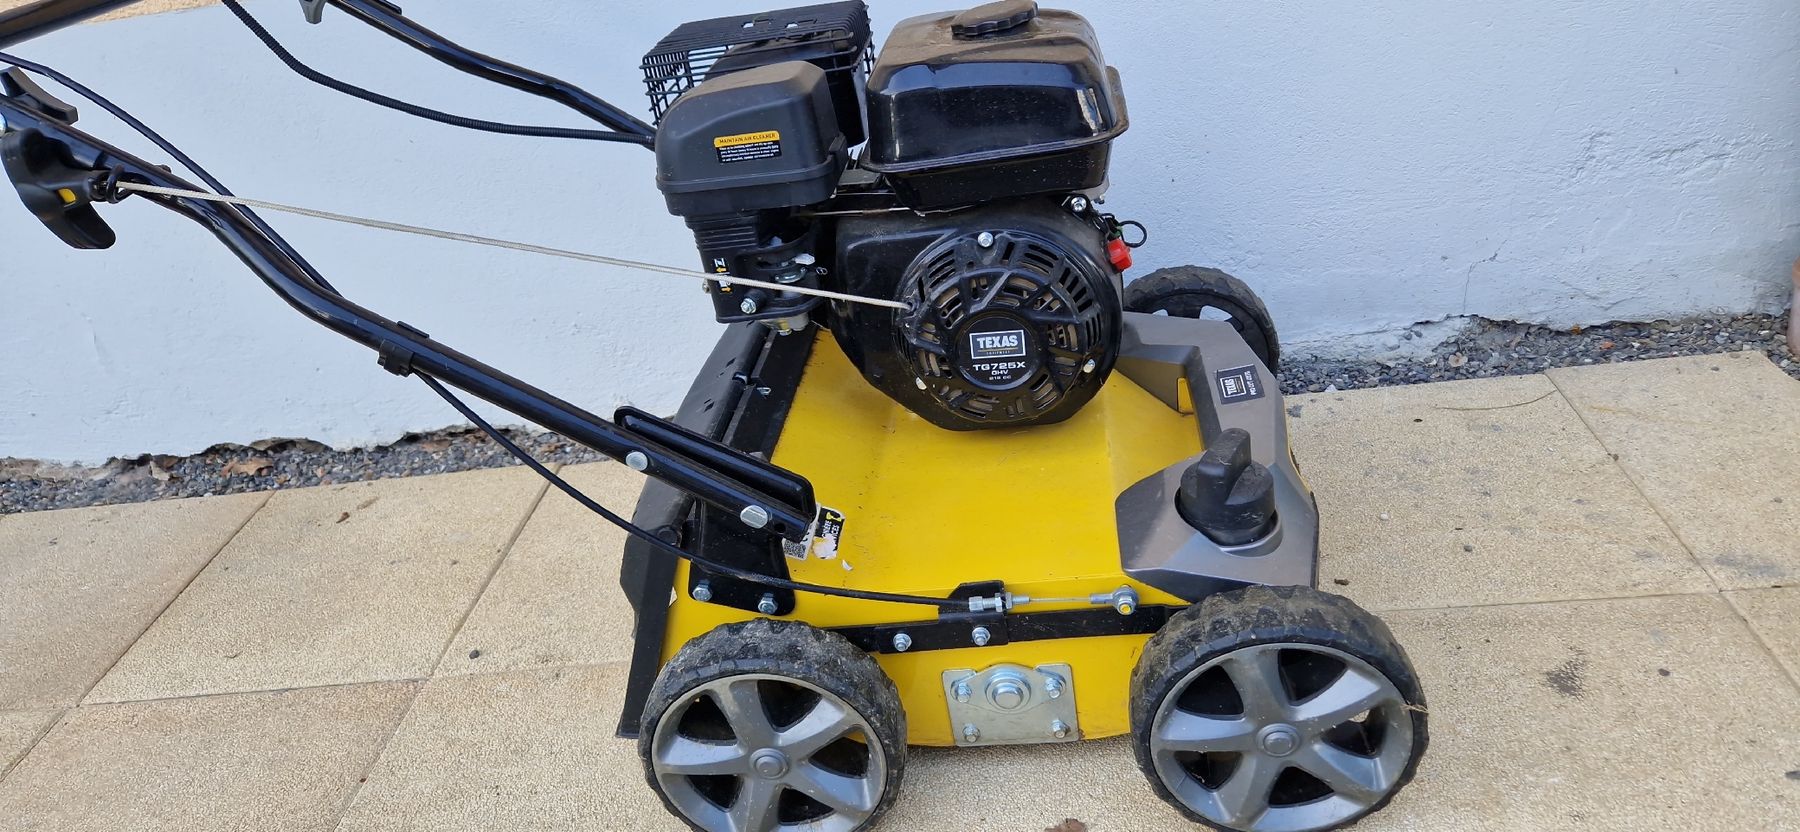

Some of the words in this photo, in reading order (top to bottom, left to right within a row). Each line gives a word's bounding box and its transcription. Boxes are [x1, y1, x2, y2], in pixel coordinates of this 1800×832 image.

[976, 335, 1019, 349] TEXAS
[972, 361, 1026, 371] TG725X
[1224, 378, 1238, 395] TEXAS
